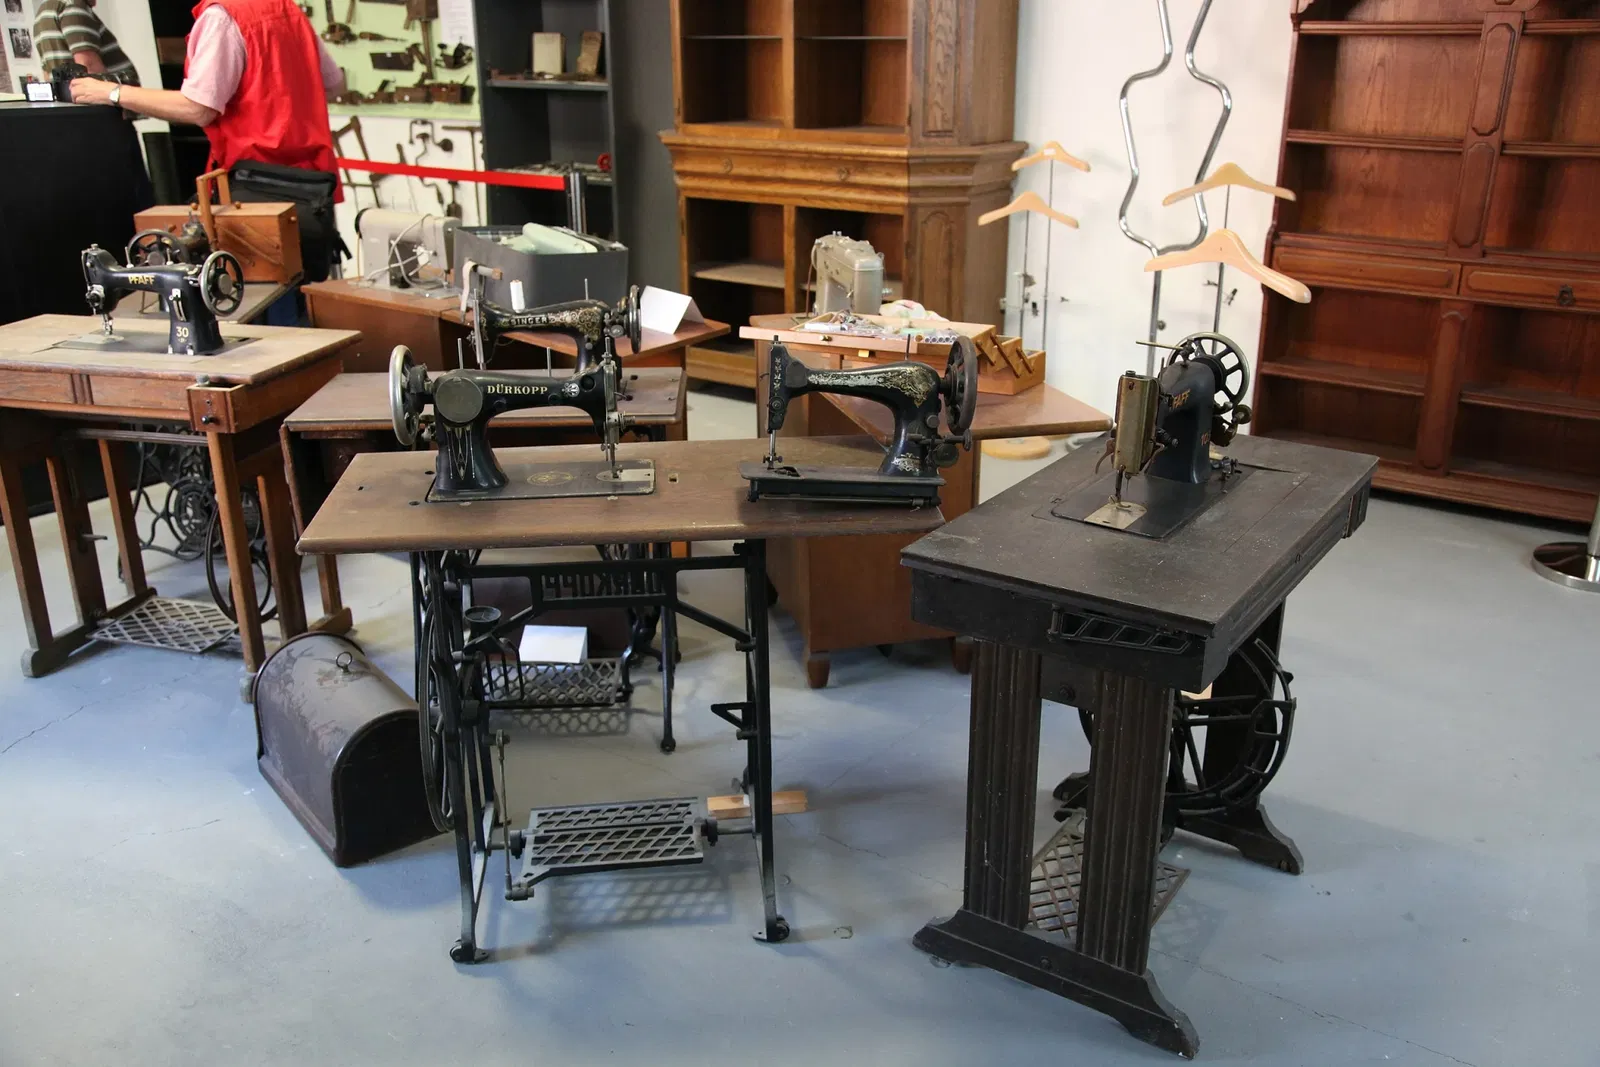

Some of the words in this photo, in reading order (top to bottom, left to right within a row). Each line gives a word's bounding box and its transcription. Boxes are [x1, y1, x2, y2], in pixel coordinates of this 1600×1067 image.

[128, 272, 155, 285] PFAFF
[510, 316, 547, 325] SINGER
[176, 326, 189, 337] 30
[487, 384, 548, 394] DÜRKOPP
